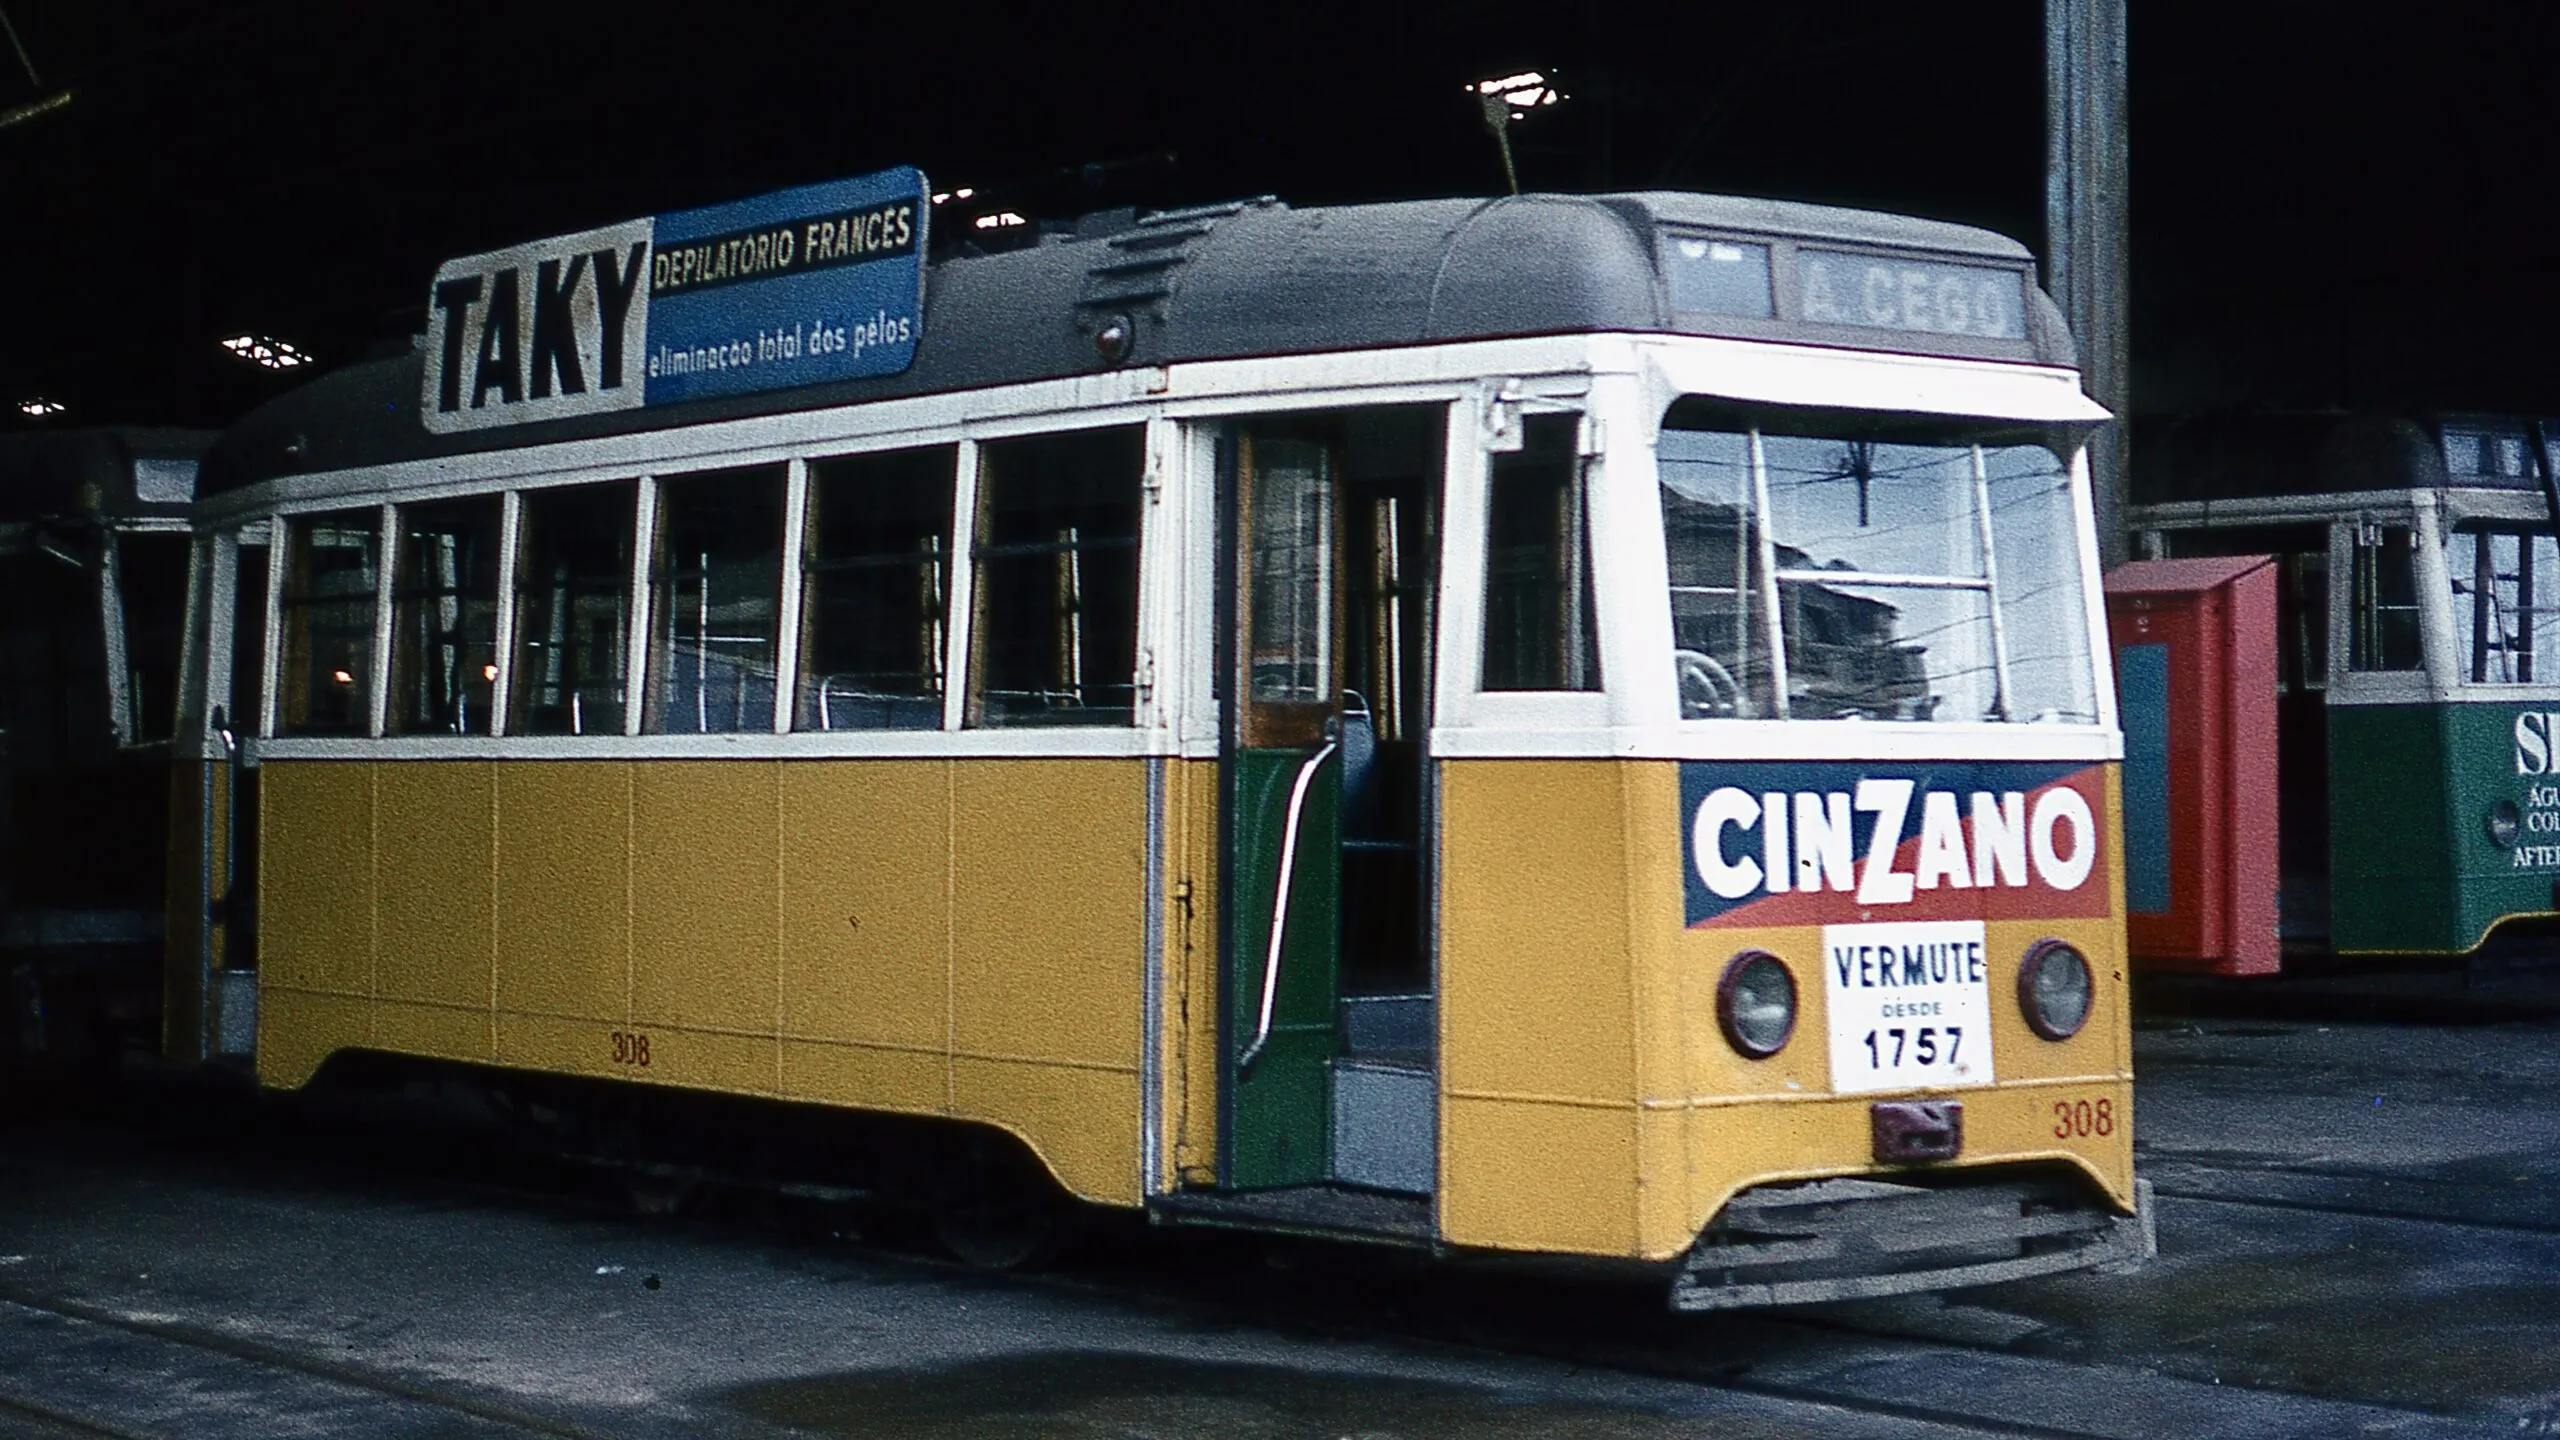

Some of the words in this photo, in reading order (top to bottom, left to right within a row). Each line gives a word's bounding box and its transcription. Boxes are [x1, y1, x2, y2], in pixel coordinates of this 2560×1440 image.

[1864, 265, 2008, 337] CEGO
[436, 241, 647, 413] TAKY
[758, 321, 802, 361] total
[809, 320, 846, 355] dos
[1693, 778, 2097, 905] CINZANO
[1833, 941, 1983, 989] VERMUTE
[1881, 1002, 1943, 1018] DESDE
[611, 1031, 650, 1067] 308
[1863, 1026, 1963, 1070] 1757
[2053, 1098, 2114, 1139] 308
